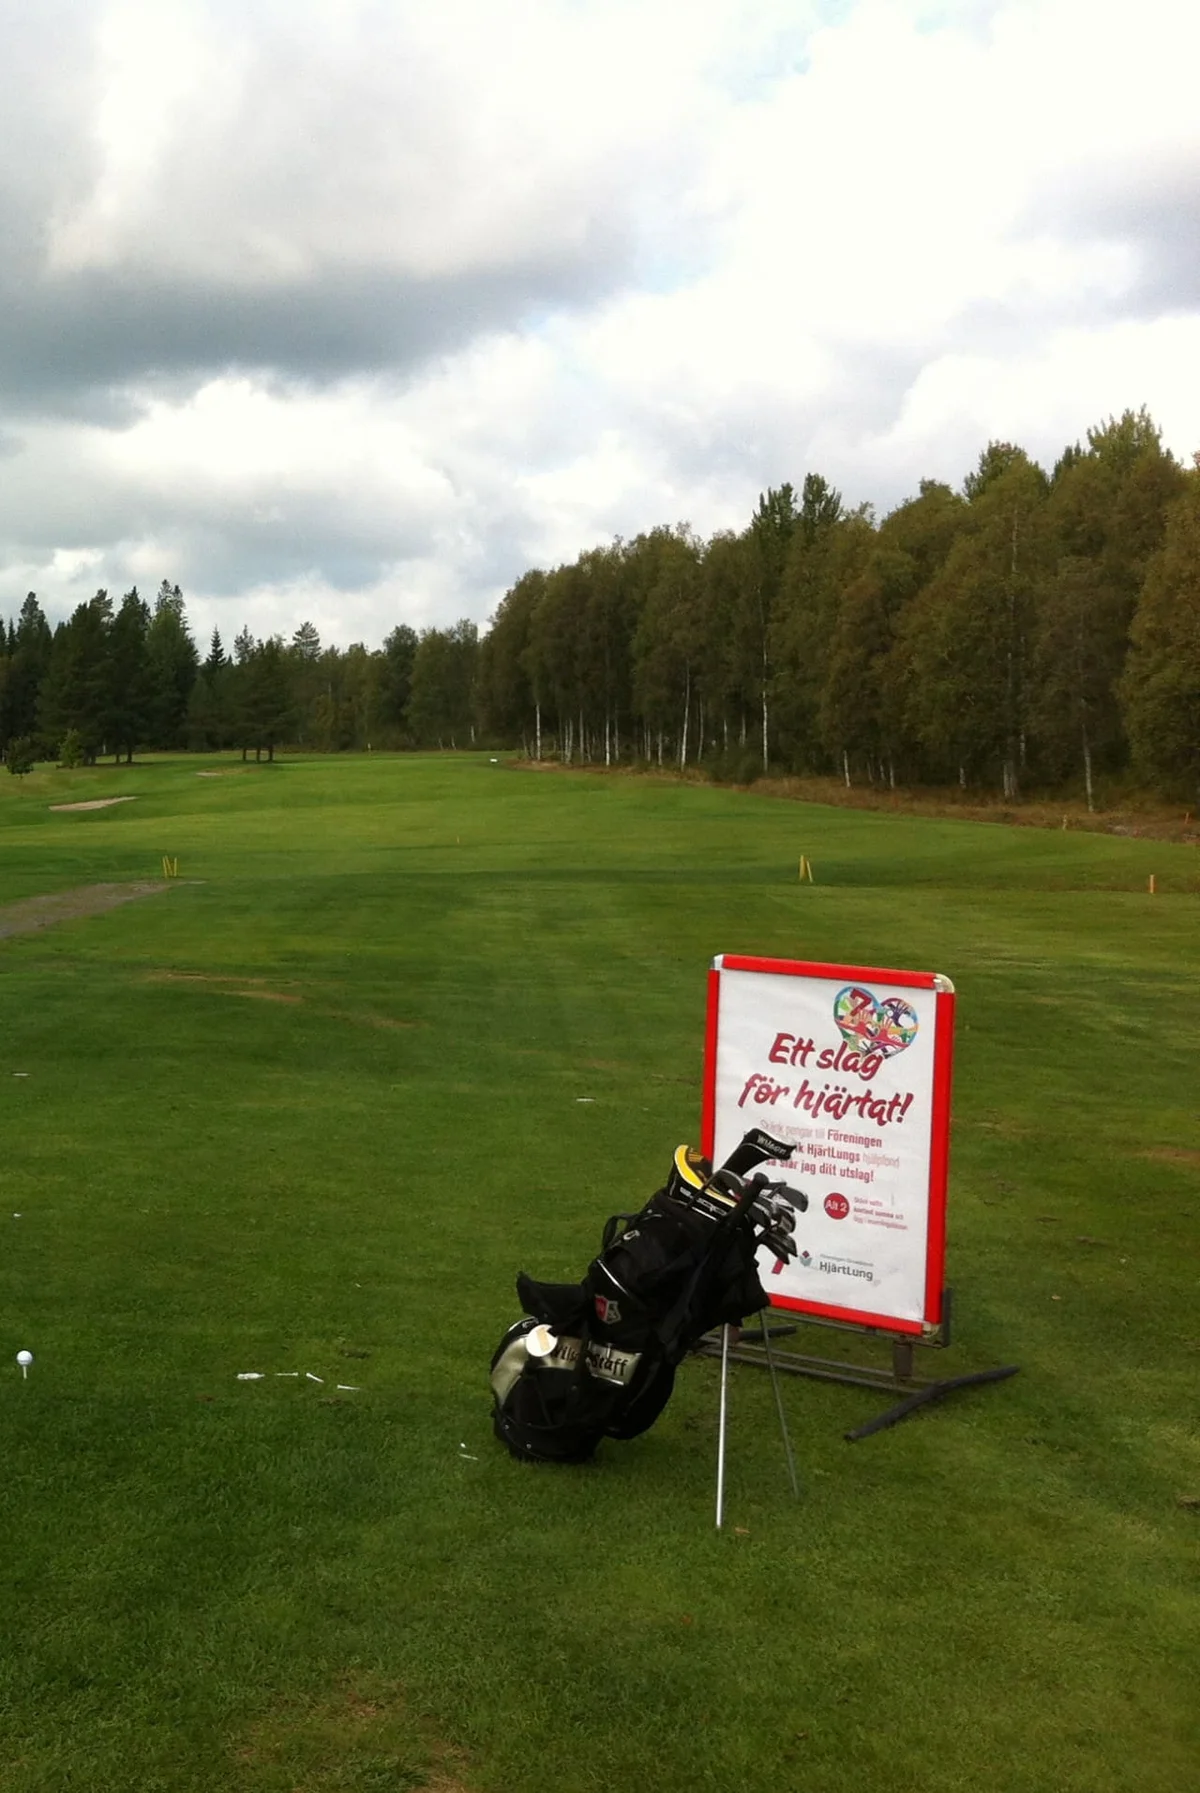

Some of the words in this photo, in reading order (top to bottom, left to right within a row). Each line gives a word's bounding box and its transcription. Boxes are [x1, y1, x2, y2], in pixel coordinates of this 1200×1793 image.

[768, 1032, 816, 1067] Ett
[816, 1041, 884, 1081] slag
[737, 1073, 790, 1108] för
[793, 1079, 914, 1126] hjärtat!
[827, 1128, 883, 1149] Föreningen
[800, 1161, 817, 1176] jag
[819, 1163, 837, 1177] ditt
[839, 1168, 875, 1184] utslag!
[840, 1202, 848, 1213] 2
[819, 1261, 874, 1282] HjärtLung
[589, 1352, 629, 1377] Staff
